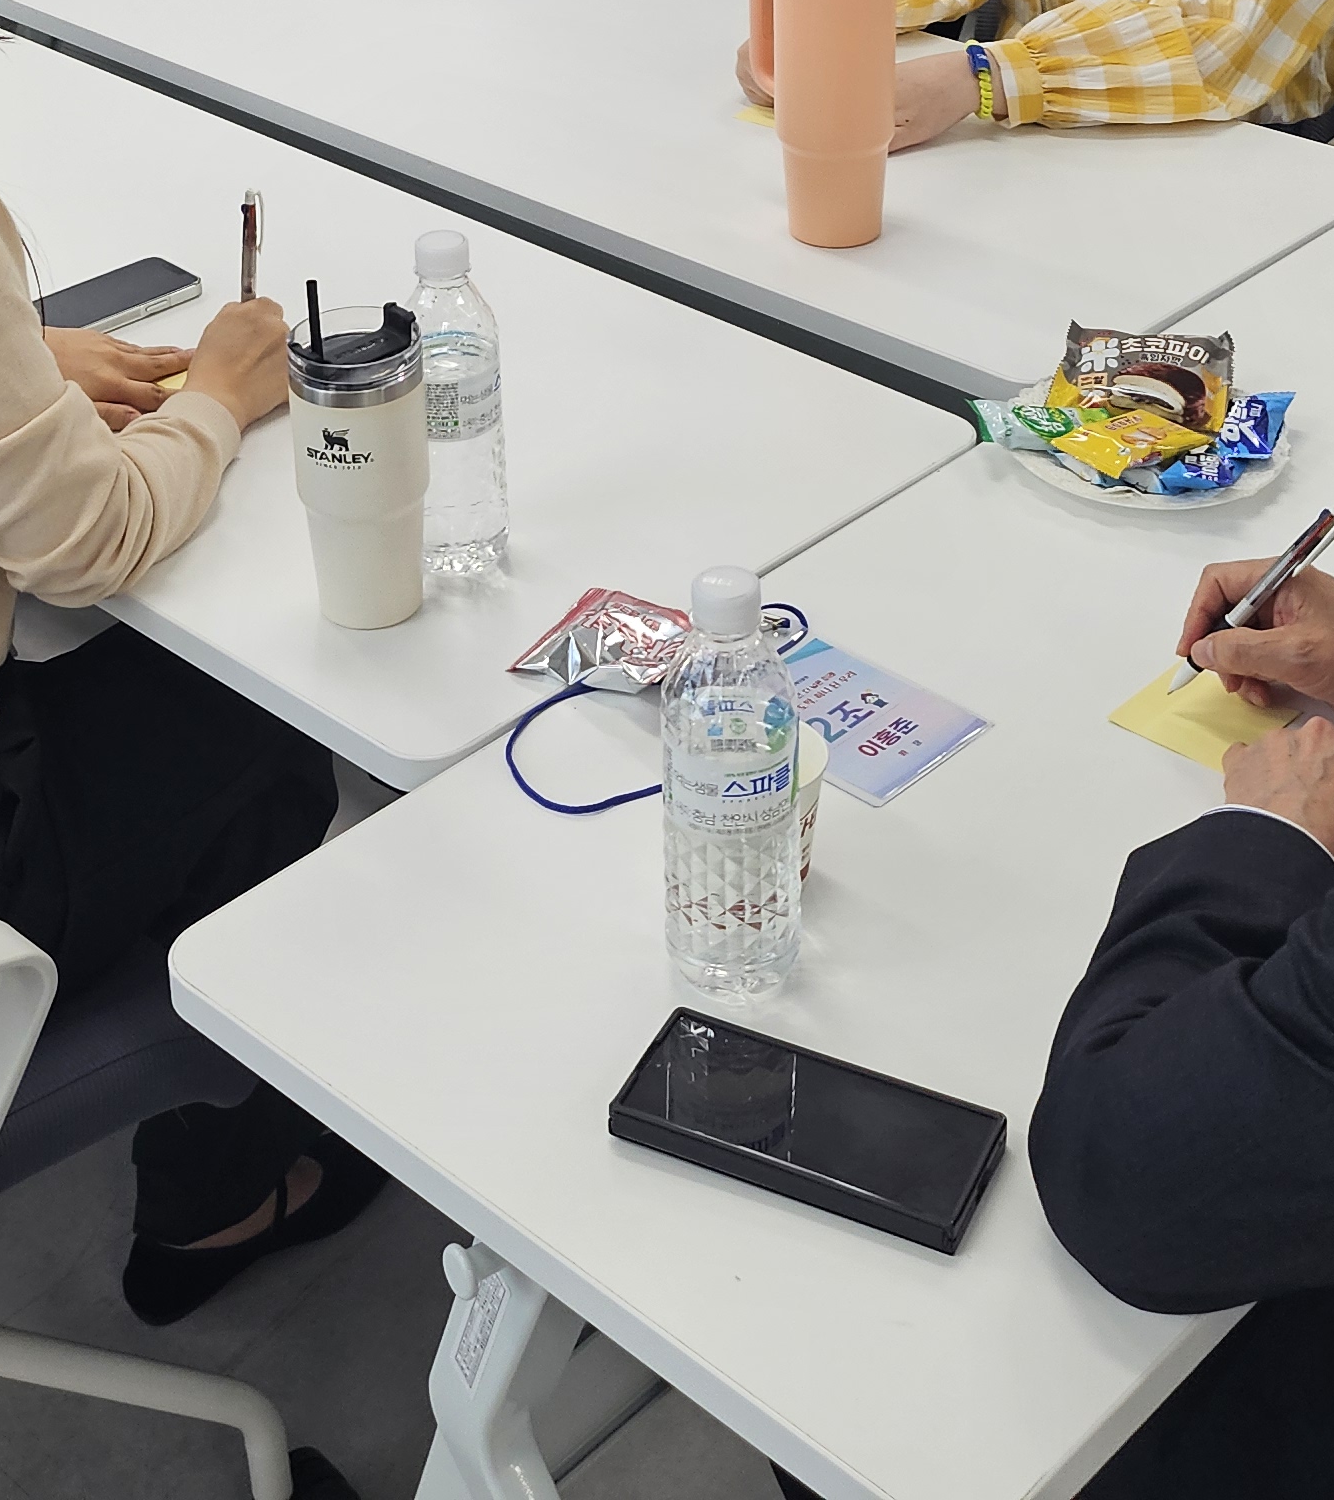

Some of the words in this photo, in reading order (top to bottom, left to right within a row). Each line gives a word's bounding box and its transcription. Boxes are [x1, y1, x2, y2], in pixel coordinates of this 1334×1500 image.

[1120, 336, 1211, 364] 초코파이
[306, 446, 373, 464] STANLEY
[805, 699, 876, 744] 2조
[857, 716, 920, 757] 이홍준
[722, 762, 791, 798] 스파클
